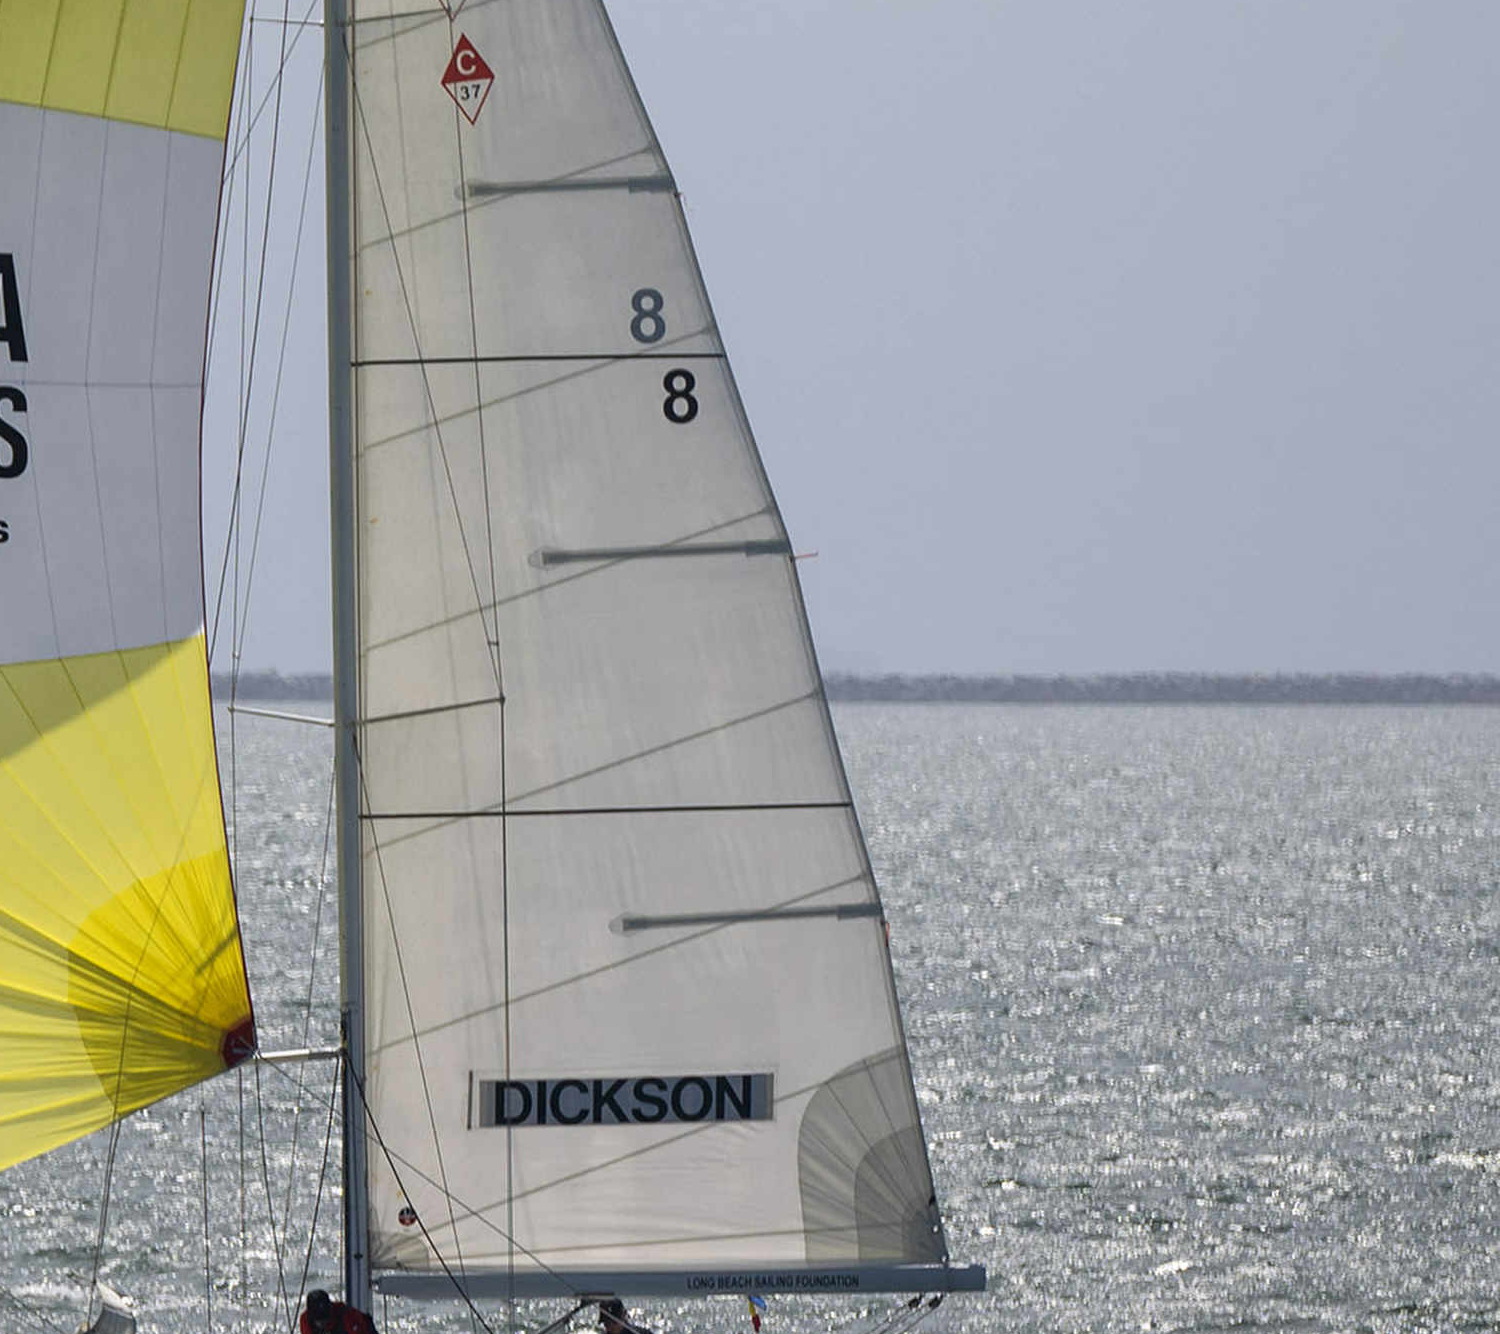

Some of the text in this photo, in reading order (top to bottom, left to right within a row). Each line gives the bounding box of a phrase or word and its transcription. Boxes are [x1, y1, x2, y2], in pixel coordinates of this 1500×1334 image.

[456, 50, 476, 75] C
[459, 83, 481, 100] 37
[662, 368, 699, 424] 8
[493, 1073, 752, 1126] DICKSON
[686, 1273, 860, 1289] LONG BEACH SAILING FOUNDATION
